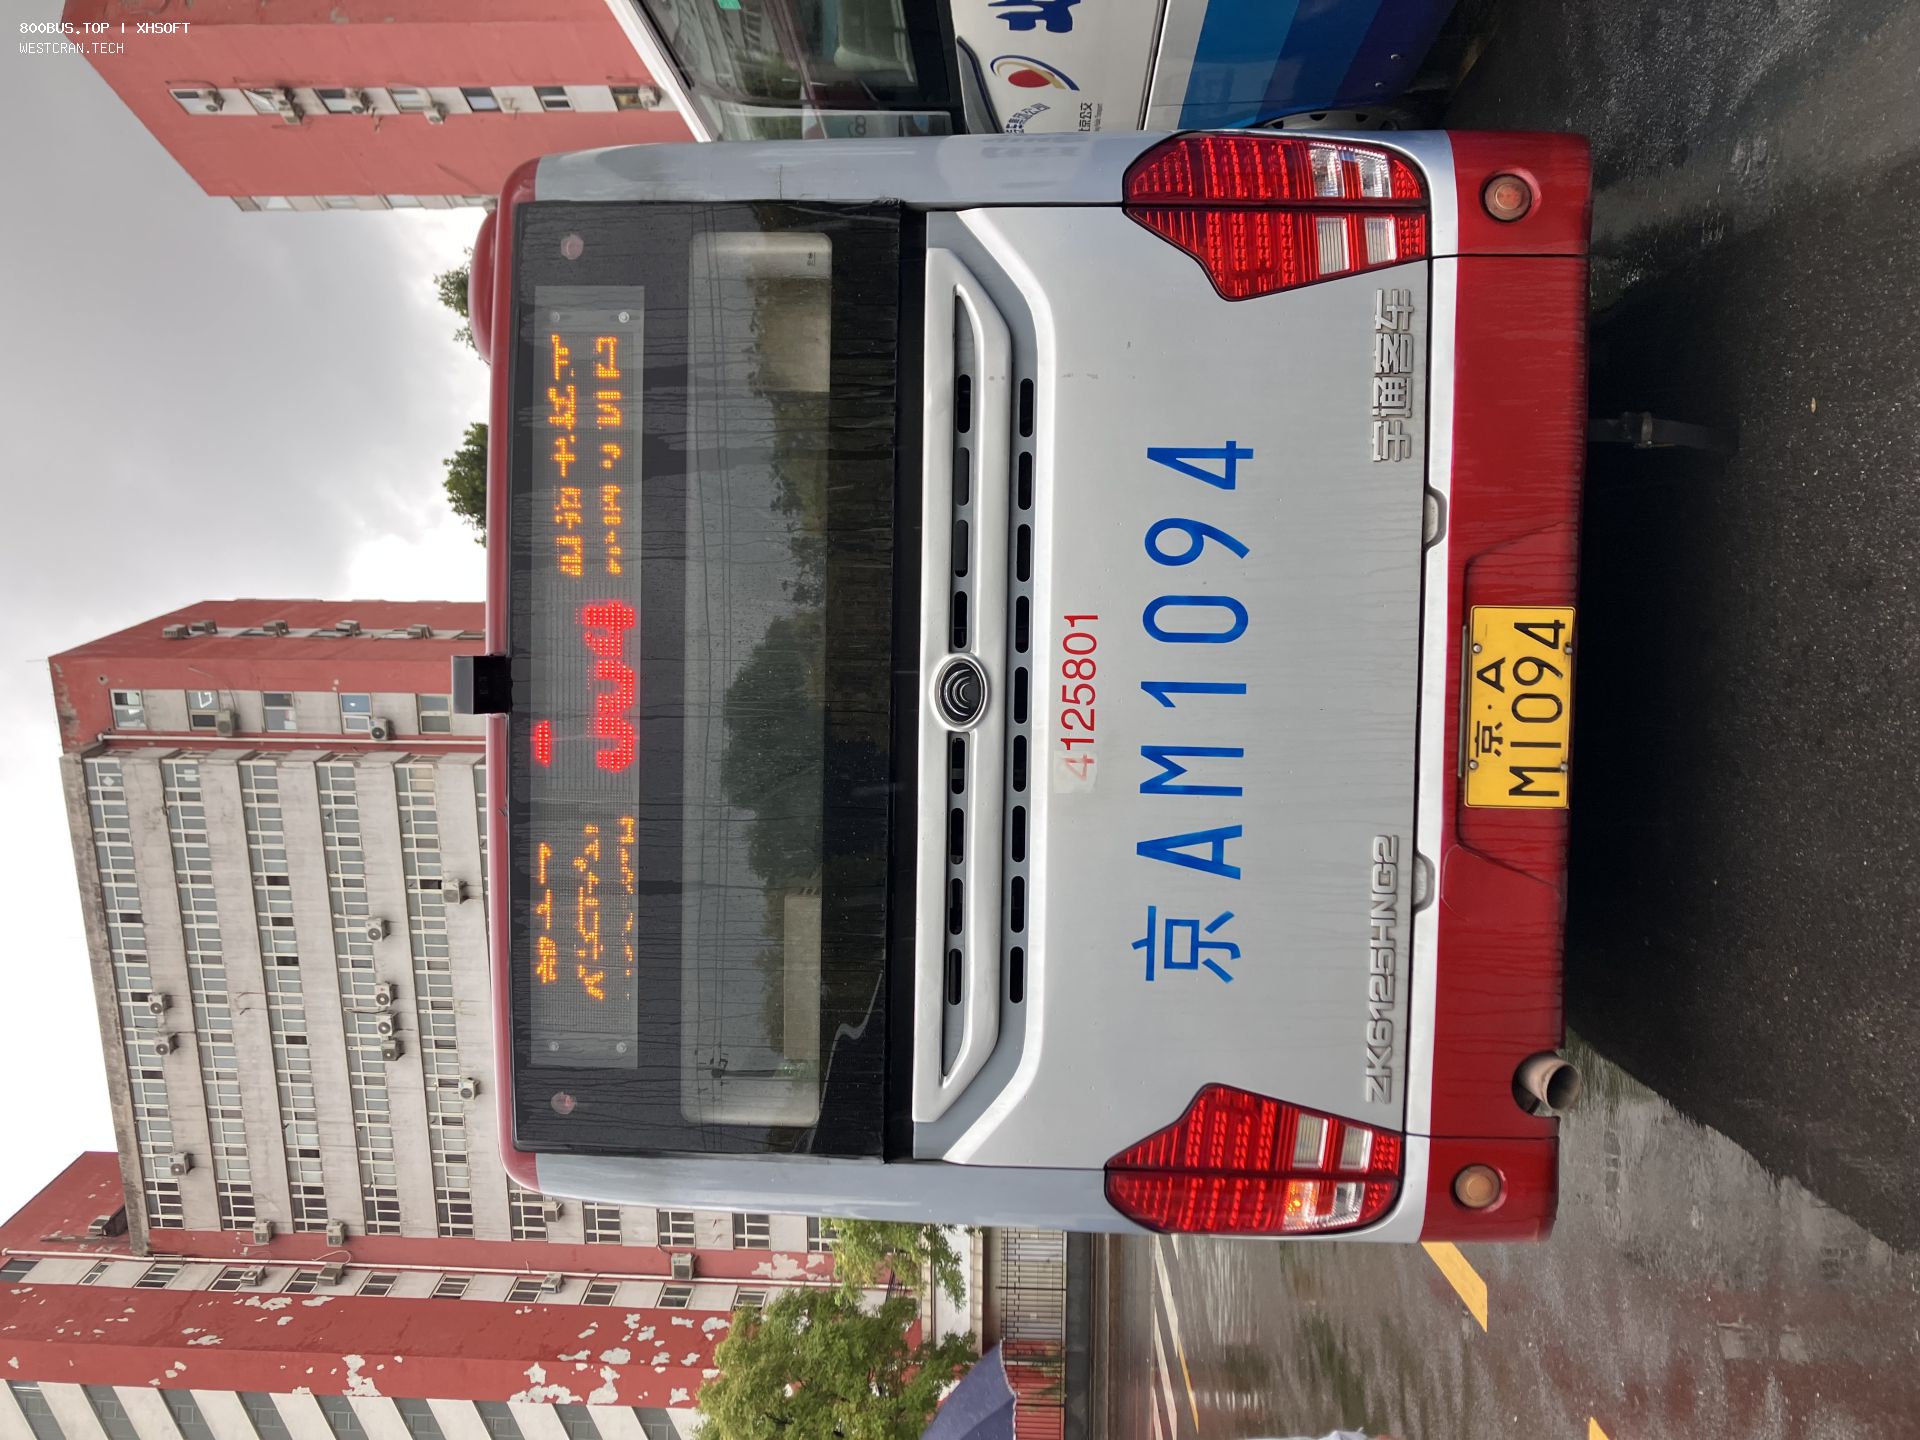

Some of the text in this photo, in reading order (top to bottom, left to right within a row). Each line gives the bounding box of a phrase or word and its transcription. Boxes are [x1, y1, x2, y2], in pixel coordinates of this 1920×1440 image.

[1371, 289, 1414, 462] 宇通客车
[1059, 613, 1099, 781] 4125801
[1131, 440, 1254, 984] 京AM1094
[1508, 620, 1566, 797] M1094
[1364, 835, 1399, 1104] ZK6125HNG2
